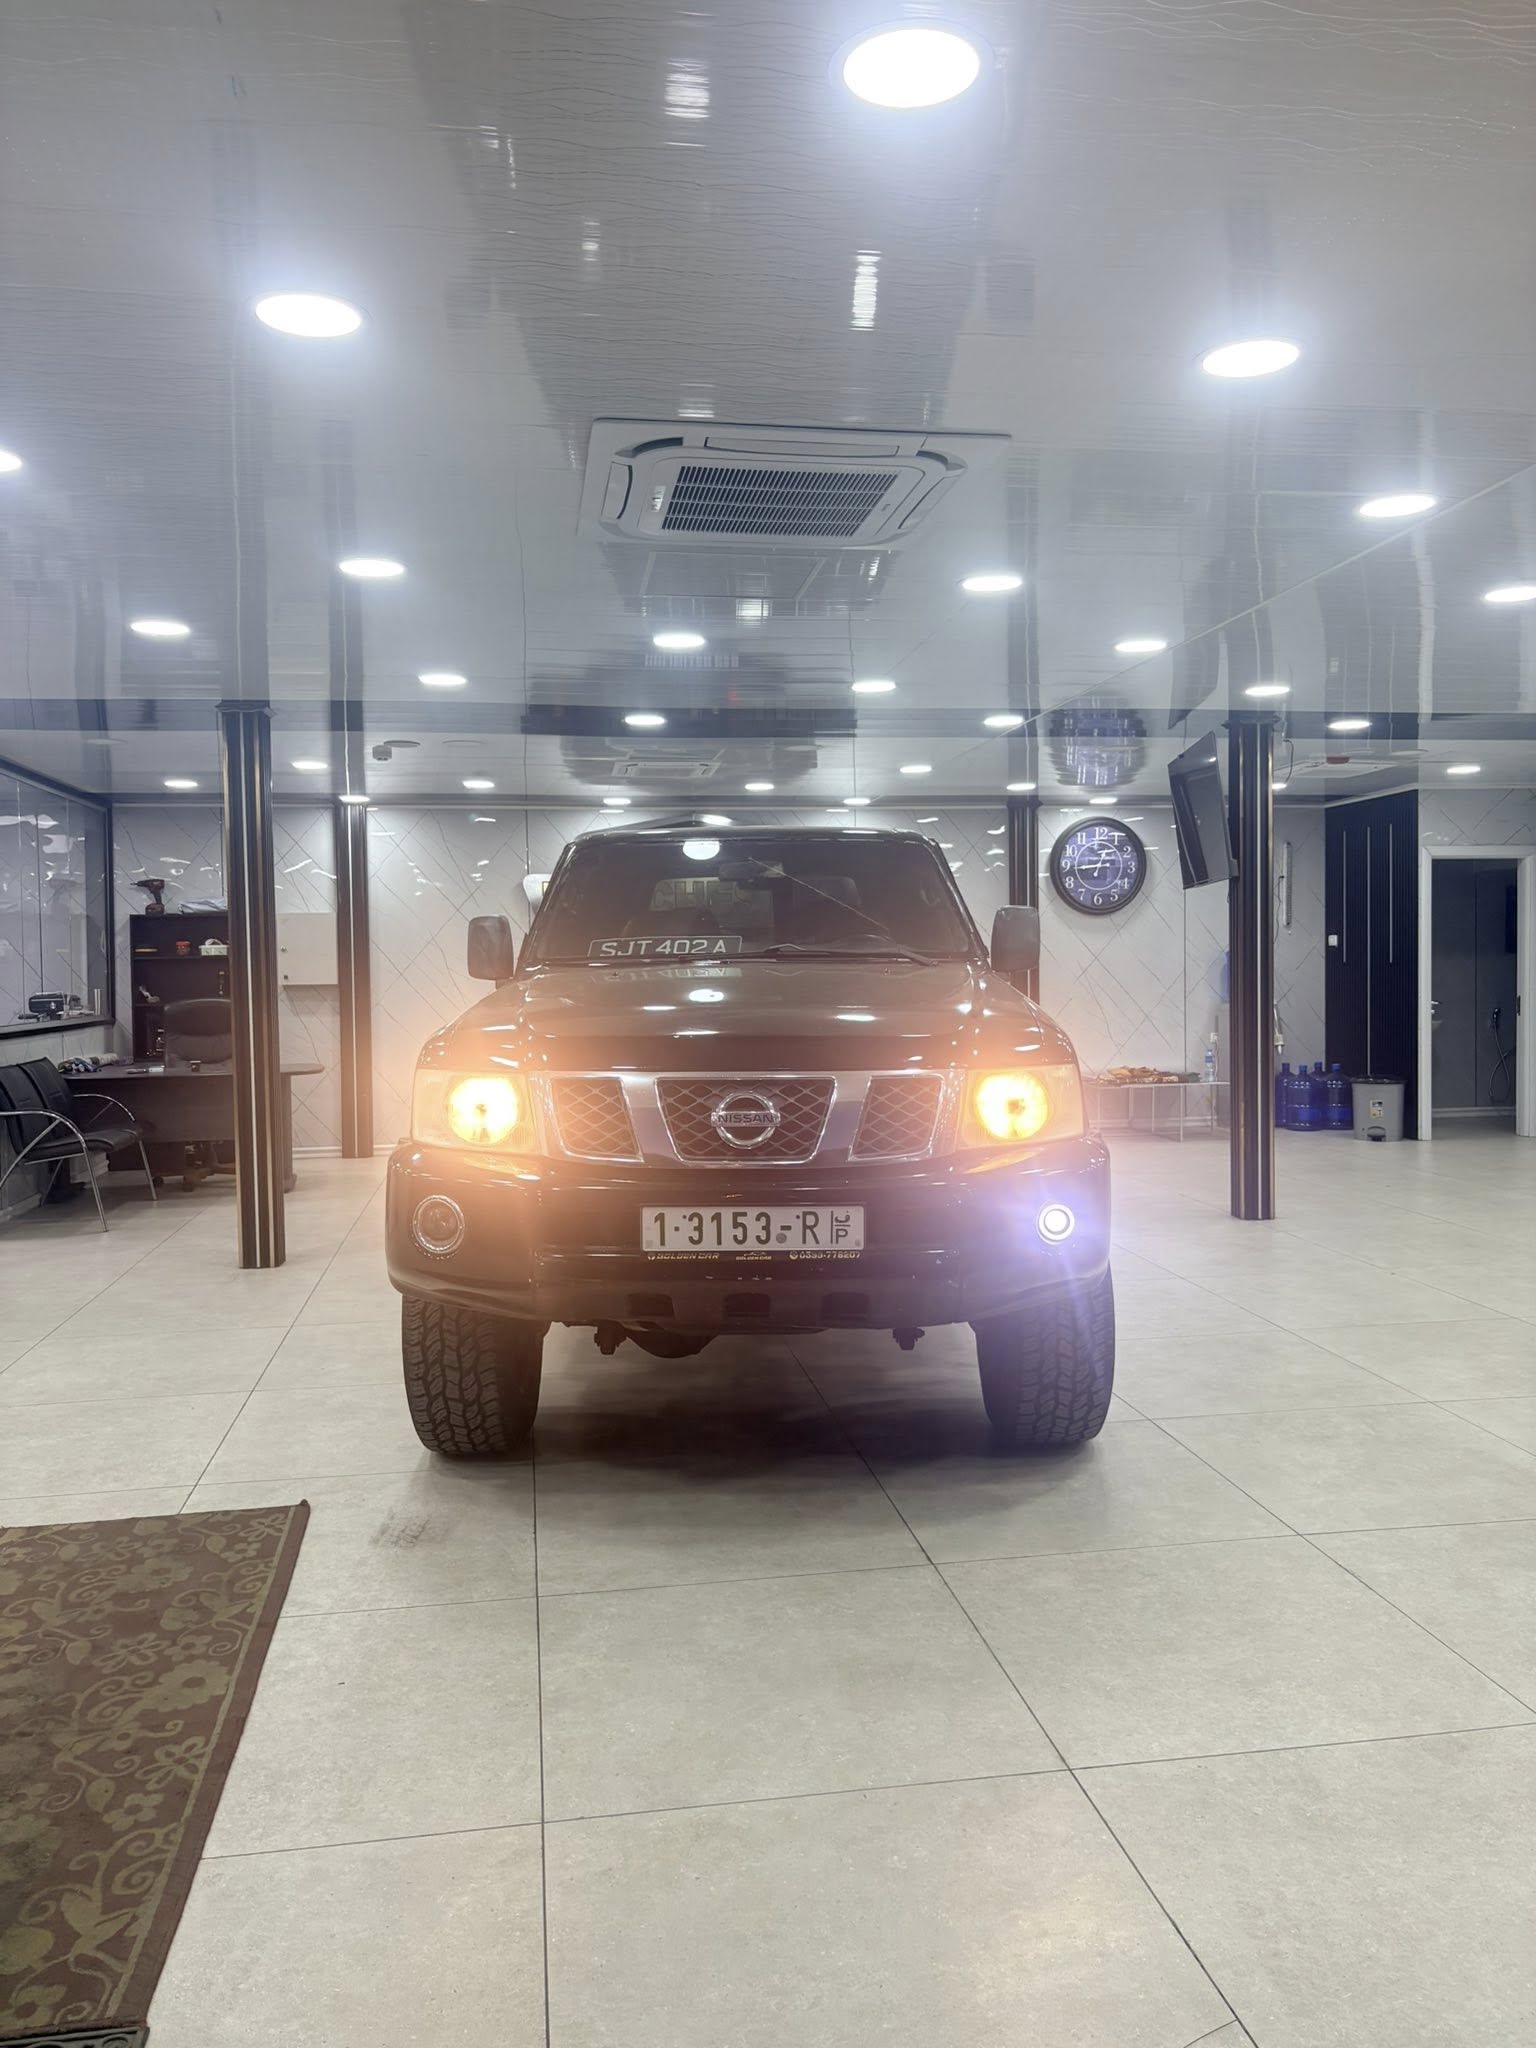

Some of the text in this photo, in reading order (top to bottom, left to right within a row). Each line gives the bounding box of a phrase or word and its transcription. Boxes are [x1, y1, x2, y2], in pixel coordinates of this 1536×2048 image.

[1077, 832, 1086, 844] 11
[1094, 827, 1108, 840] 12
[1065, 845, 1077, 857] 10
[1123, 846, 1131, 858] 2
[1062, 859, 1070, 872] 9
[1127, 861, 1136, 873] 3
[1065, 876, 1074, 888] 8
[1121, 878, 1130, 889] 4
[1078, 889, 1086, 900] 7
[1093, 893, 1102, 905] 6
[1110, 890, 1119, 902] 5
[718, 1114, 774, 1123] NISSAN
[835, 1228, 849, 1244] P
